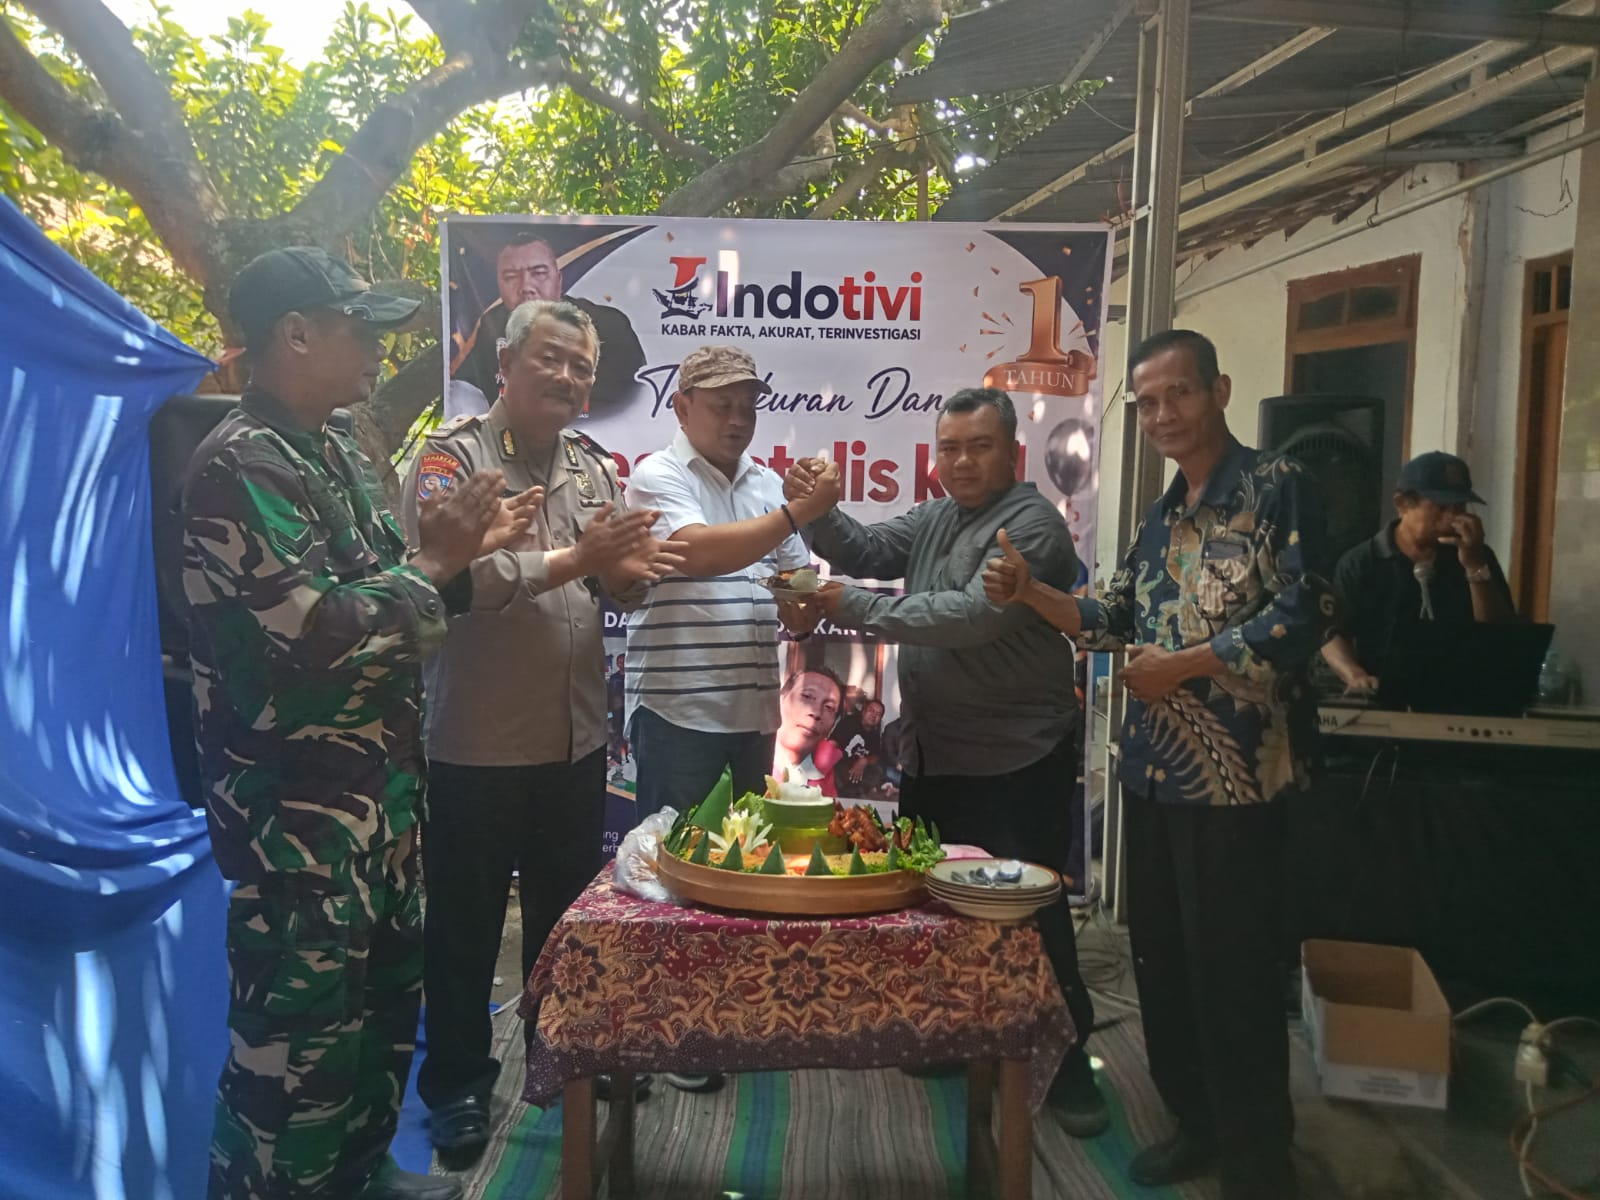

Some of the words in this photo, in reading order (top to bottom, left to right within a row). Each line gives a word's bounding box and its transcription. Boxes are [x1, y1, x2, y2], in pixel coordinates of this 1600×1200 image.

[716, 270, 923, 321] Indotivi
[661, 324, 709, 336] KABAR
[710, 325, 755, 340] FAKTA,
[758, 326, 815, 340] AKURAT,
[819, 327, 921, 340] TERINVESTIGASI
[1016, 275, 1069, 364] 1
[864, 366, 943, 419] Dan
[1004, 369, 1075, 389] TAHUN
[604, 611, 628, 628] DA
